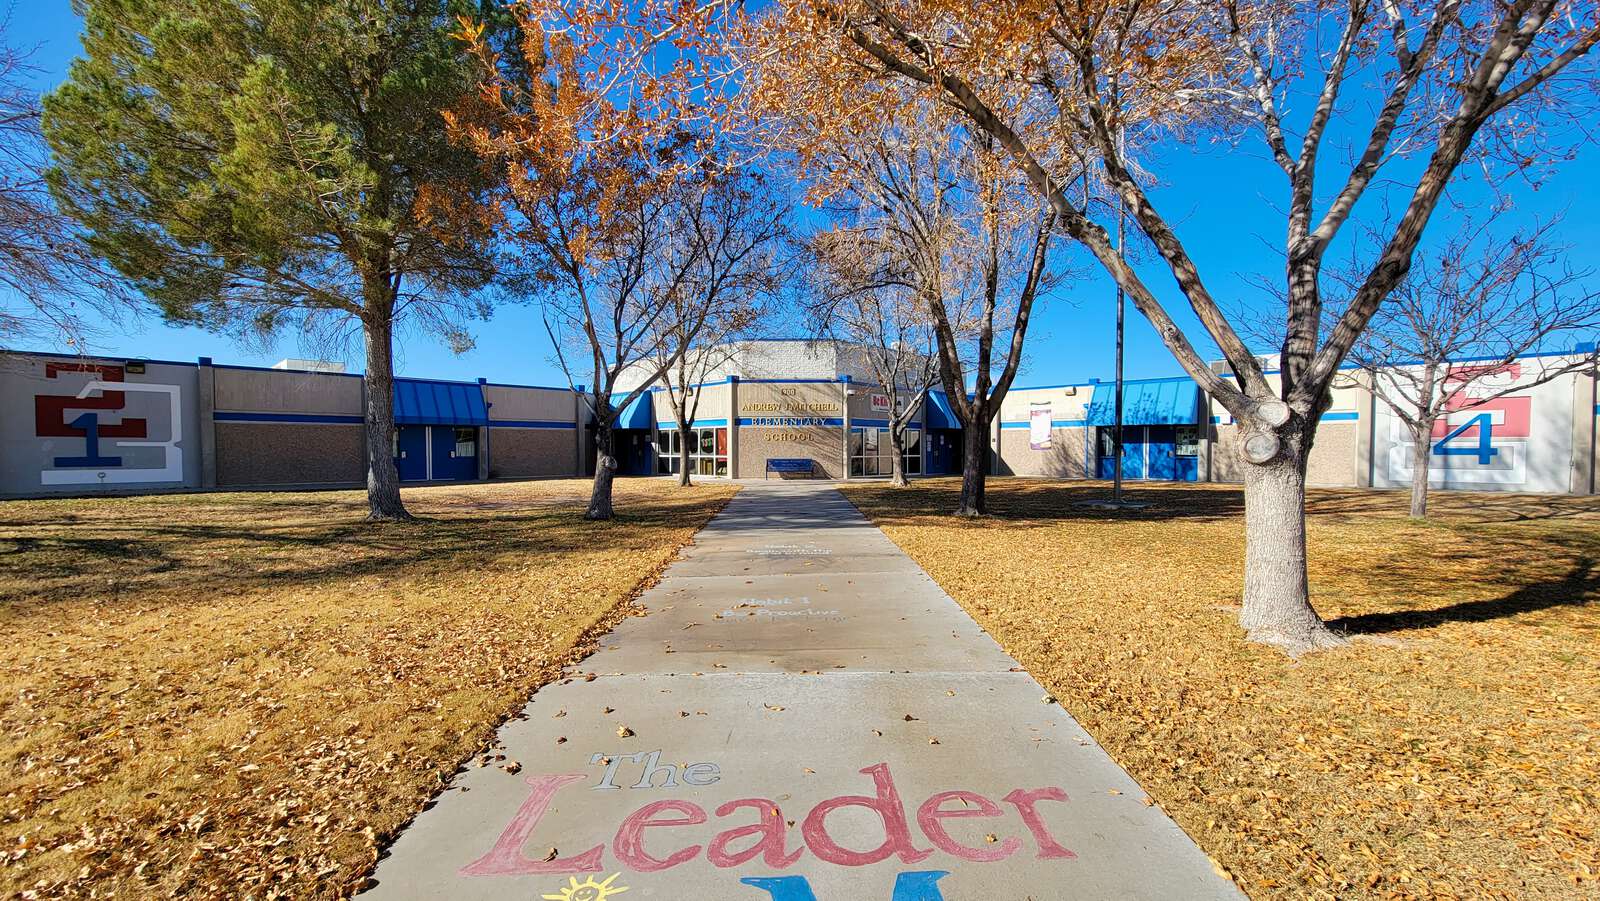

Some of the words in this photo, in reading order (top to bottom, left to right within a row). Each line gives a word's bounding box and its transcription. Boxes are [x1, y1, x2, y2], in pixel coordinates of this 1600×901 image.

[35, 362, 147, 437] 2
[742, 402, 782, 412] ANDREW
[789, 402, 839, 412] MITCHELL
[751, 417, 826, 426] ELEMENTARY
[41, 381, 183, 485] 3
[54, 412, 122, 467] 1
[764, 432, 815, 442] SCHOOL
[1433, 413, 1498, 465] 4
[589, 749, 721, 790] The
[456, 762, 1078, 875] Leader
